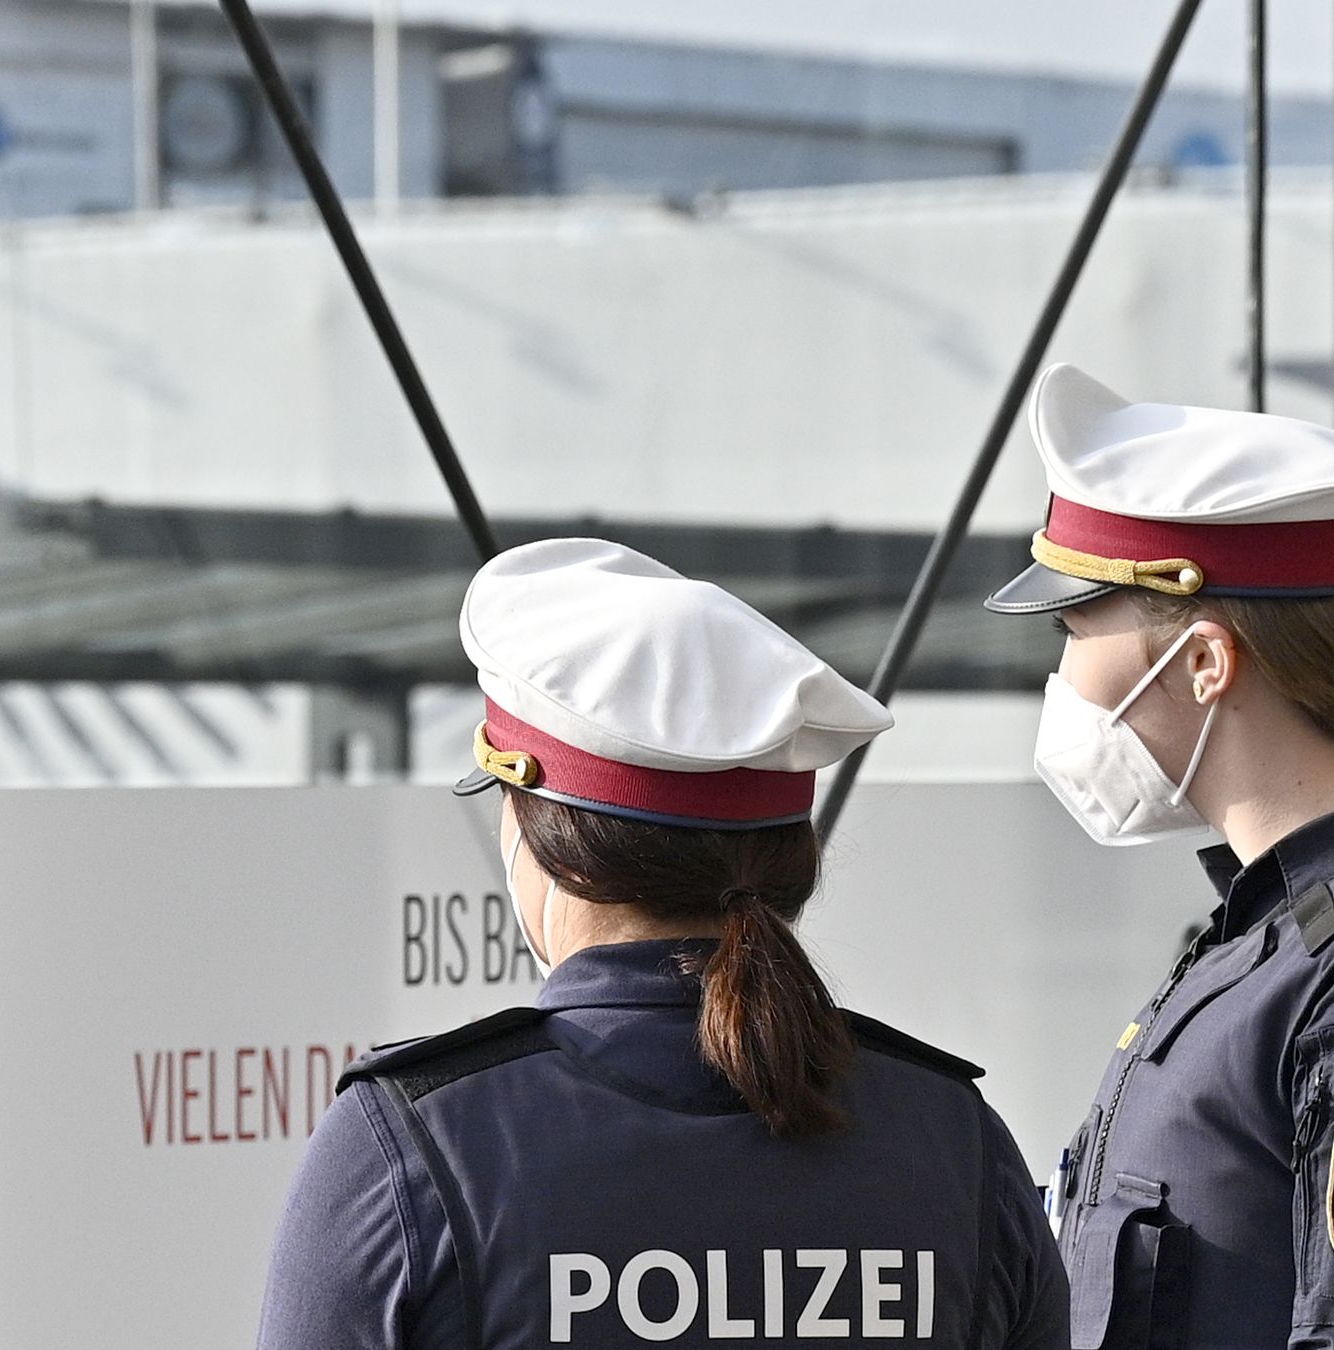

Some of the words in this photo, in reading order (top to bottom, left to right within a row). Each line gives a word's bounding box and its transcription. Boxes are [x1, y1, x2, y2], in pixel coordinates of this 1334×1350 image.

[403, 893, 469, 986] BIS
[483, 892, 539, 984] BA
[133, 1046, 291, 1146] VIELEN
[549, 1248, 935, 1343] POLIZEI
